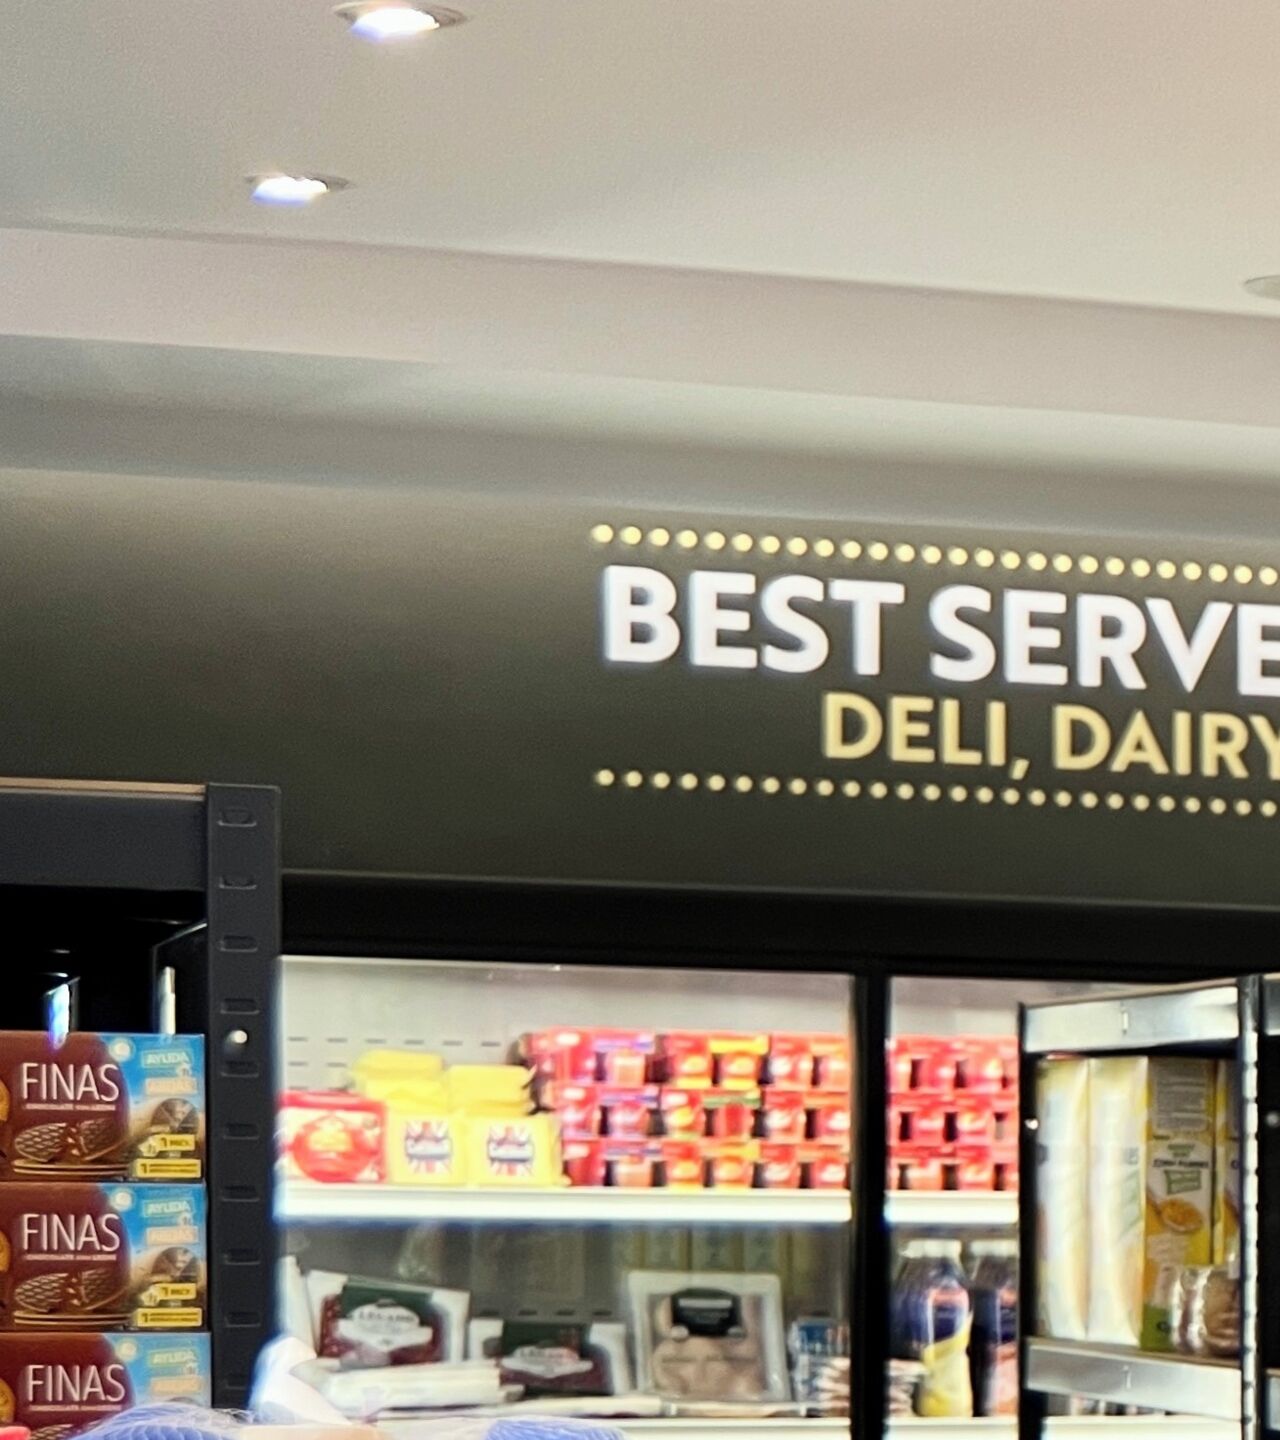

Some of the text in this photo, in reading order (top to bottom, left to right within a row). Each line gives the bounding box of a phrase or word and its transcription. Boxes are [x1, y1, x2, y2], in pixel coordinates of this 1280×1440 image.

[603, 564, 905, 677] BEST
[825, 692, 1029, 778] DELI,
[22, 1062, 119, 1101] FINAS
[23, 1213, 120, 1251] FINAS
[27, 1364, 126, 1402] FINAS
